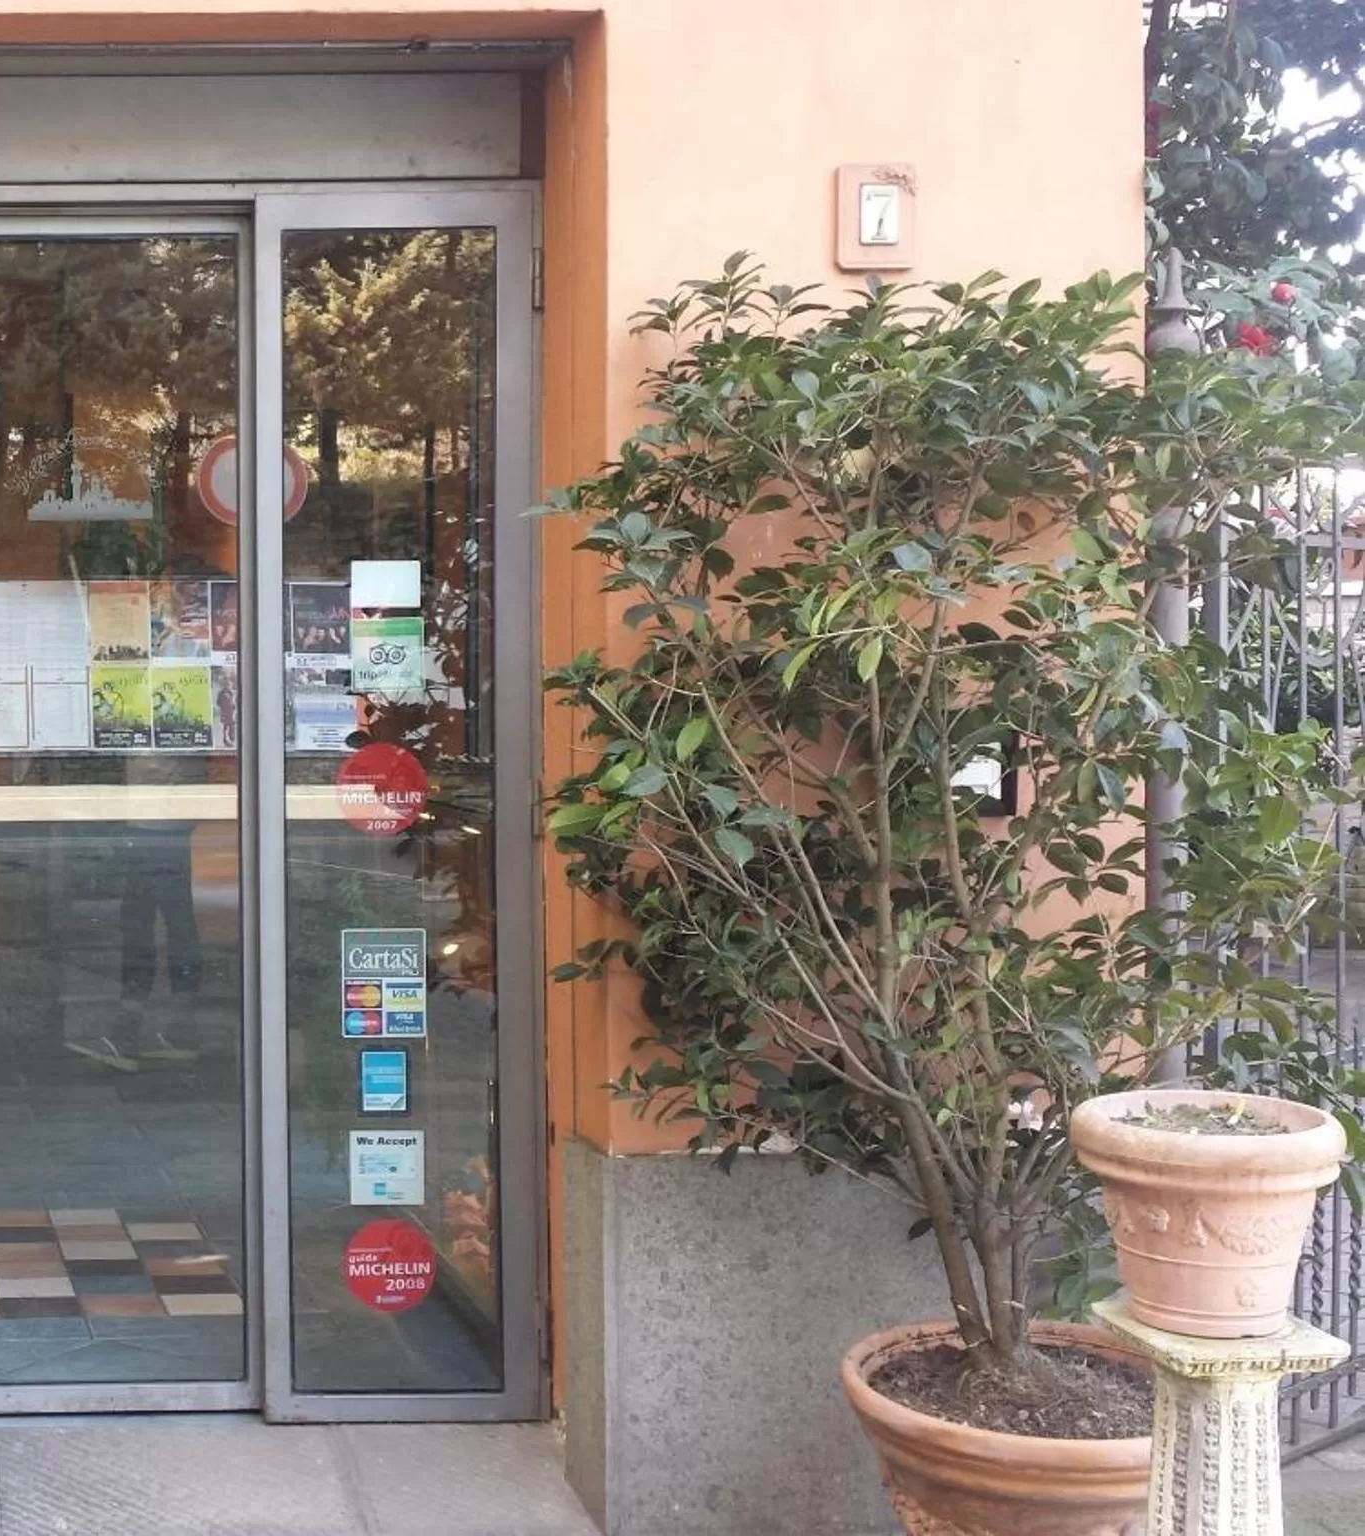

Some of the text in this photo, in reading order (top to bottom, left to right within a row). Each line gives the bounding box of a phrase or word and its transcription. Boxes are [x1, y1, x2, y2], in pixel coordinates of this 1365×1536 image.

[342, 791, 422, 804] MICHELIN
[367, 820, 398, 831] 2007
[392, 990, 417, 999] VISA
[356, 1137, 418, 1148] We Accept
[349, 1261, 431, 1277] MICHELIN
